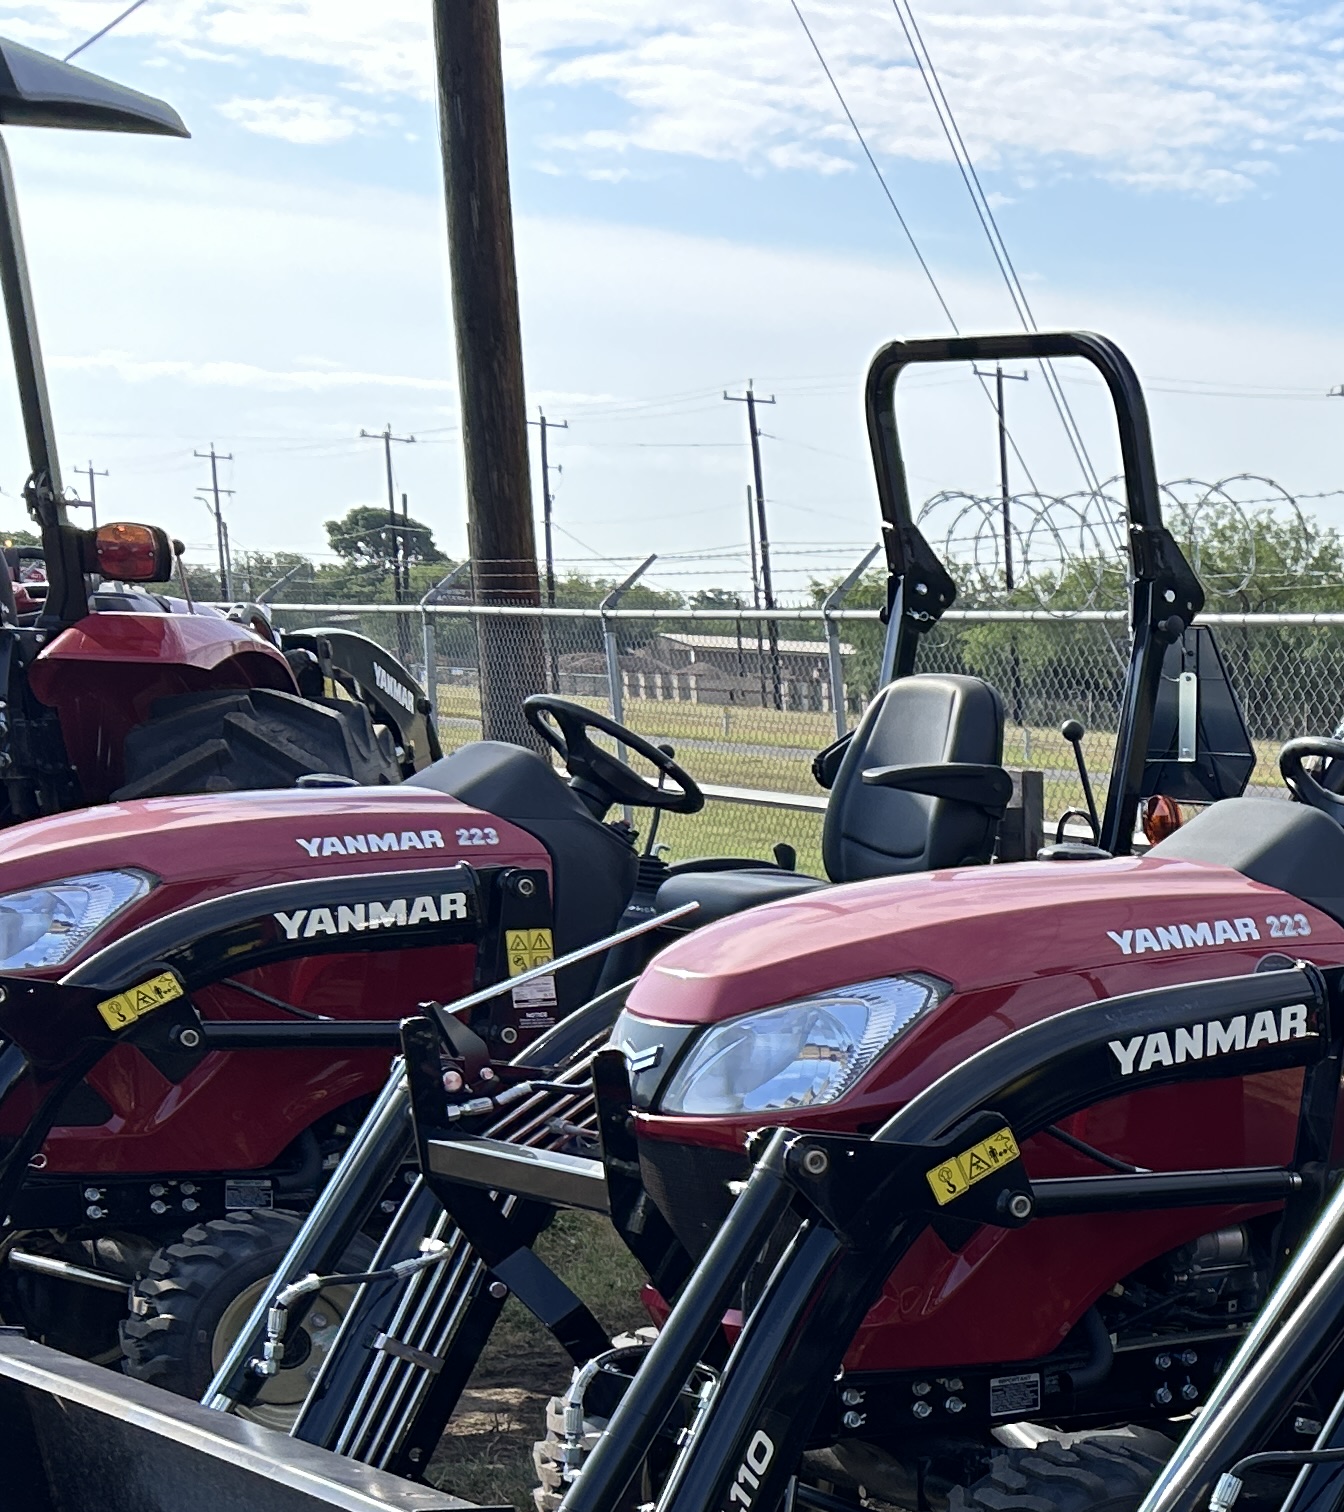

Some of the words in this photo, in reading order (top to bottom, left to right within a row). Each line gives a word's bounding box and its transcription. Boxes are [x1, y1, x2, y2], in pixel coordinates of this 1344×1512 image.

[373, 661, 415, 715] YANMAR
[296, 829, 445, 858] YANMAR
[455, 827, 500, 846] 223
[273, 892, 467, 940] YANMAR
[1107, 917, 1260, 954] YANMAR
[1265, 913, 1312, 938] 223
[1108, 1003, 1308, 1076] YANMAR
